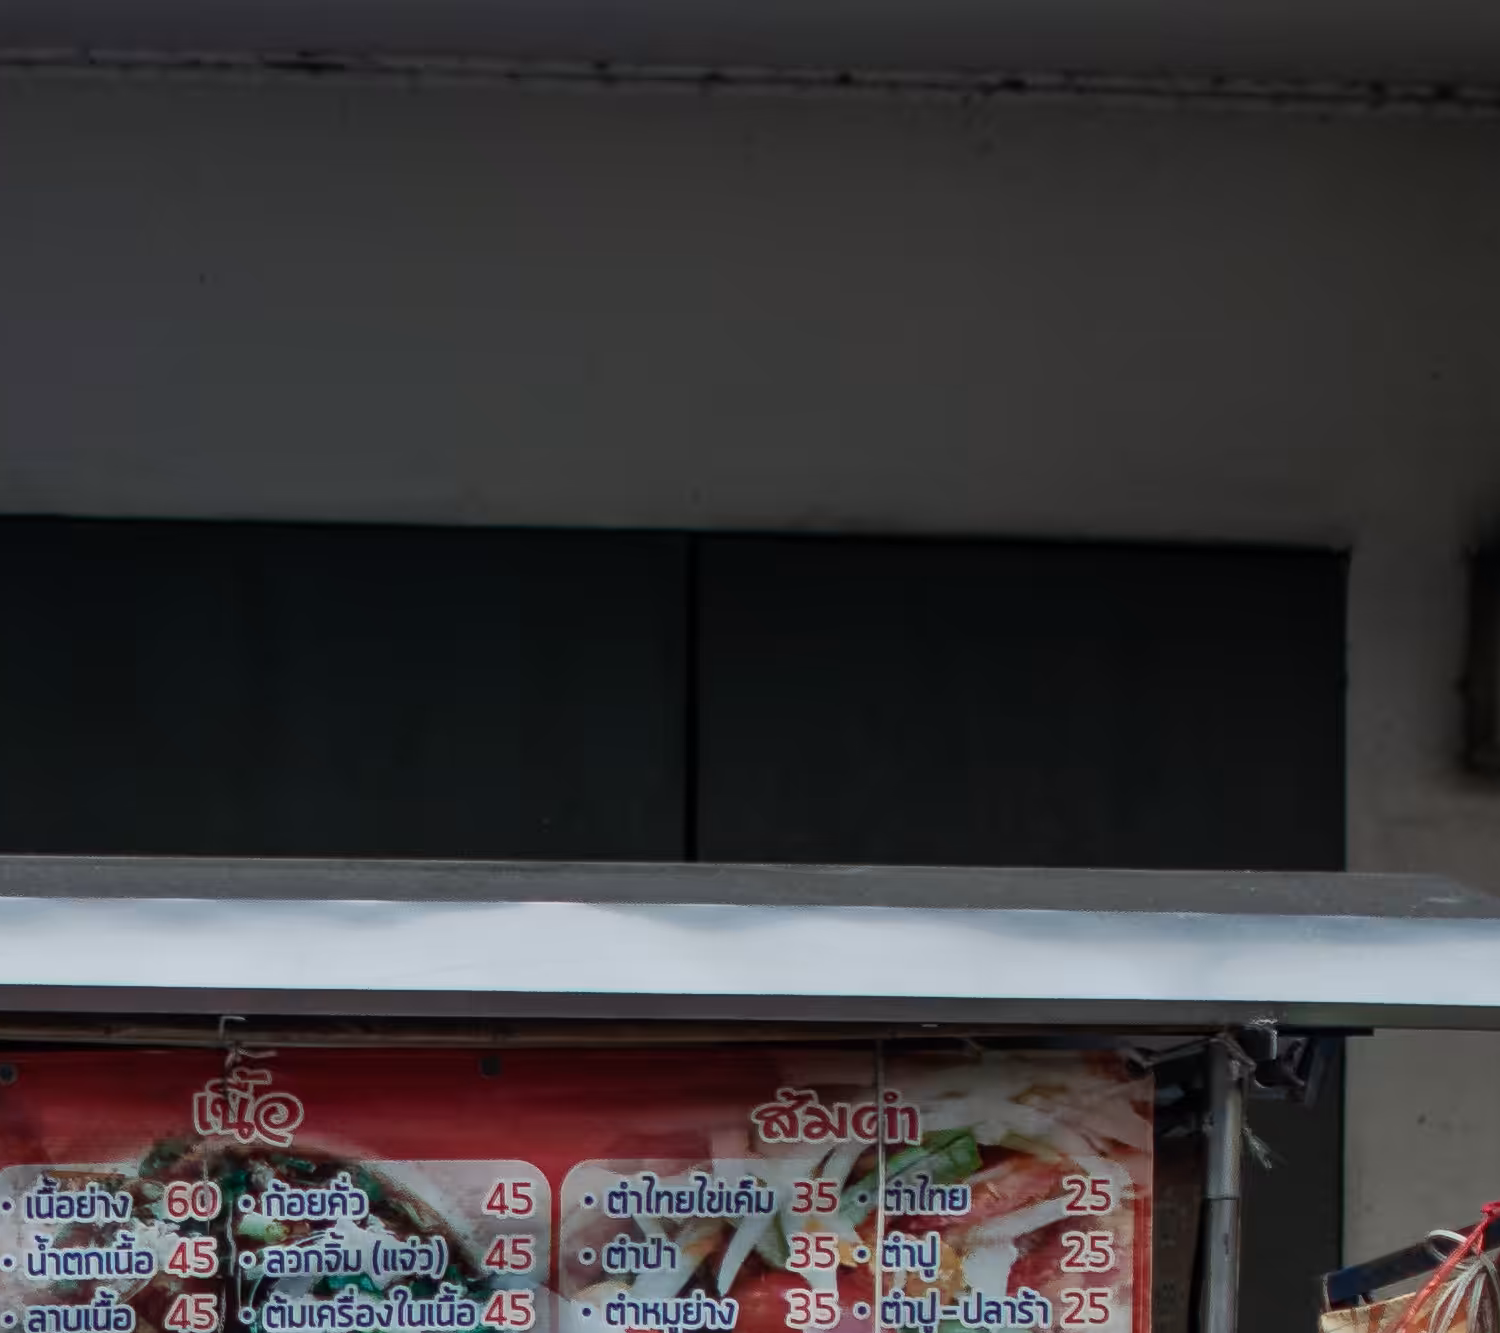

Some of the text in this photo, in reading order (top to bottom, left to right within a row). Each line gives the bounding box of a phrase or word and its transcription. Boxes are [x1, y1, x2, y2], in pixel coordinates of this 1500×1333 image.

[193, 1069, 304, 1146] เนื้อ
[754, 1089, 919, 1143] ส้มตำ
[26, 1176, 219, 1220] เนื้อย่าง 60
[265, 1175, 534, 1217] ก้อยคั่ว 45
[606, 1175, 839, 1215] ตำไทยไข่เค็ม 35
[883, 1174, 1112, 1213] ตำไทย 25
[27, 1233, 215, 1276] น้ำตกเนื้อ 45
[265, 1231, 534, 1276] ลวกจิ้ม (แจ่ว) 45
[605, 1236, 838, 1270] ตำป่า 35
[881, 1234, 1111, 1278] ตำปู 25
[27, 1290, 216, 1333] ลาบเนื้อ 45
[265, 1286, 532, 1329] ต้มเครื่องในเนื้อ 45
[789, 1291, 837, 1325] 35
[1063, 1291, 1111, 1325] 25
